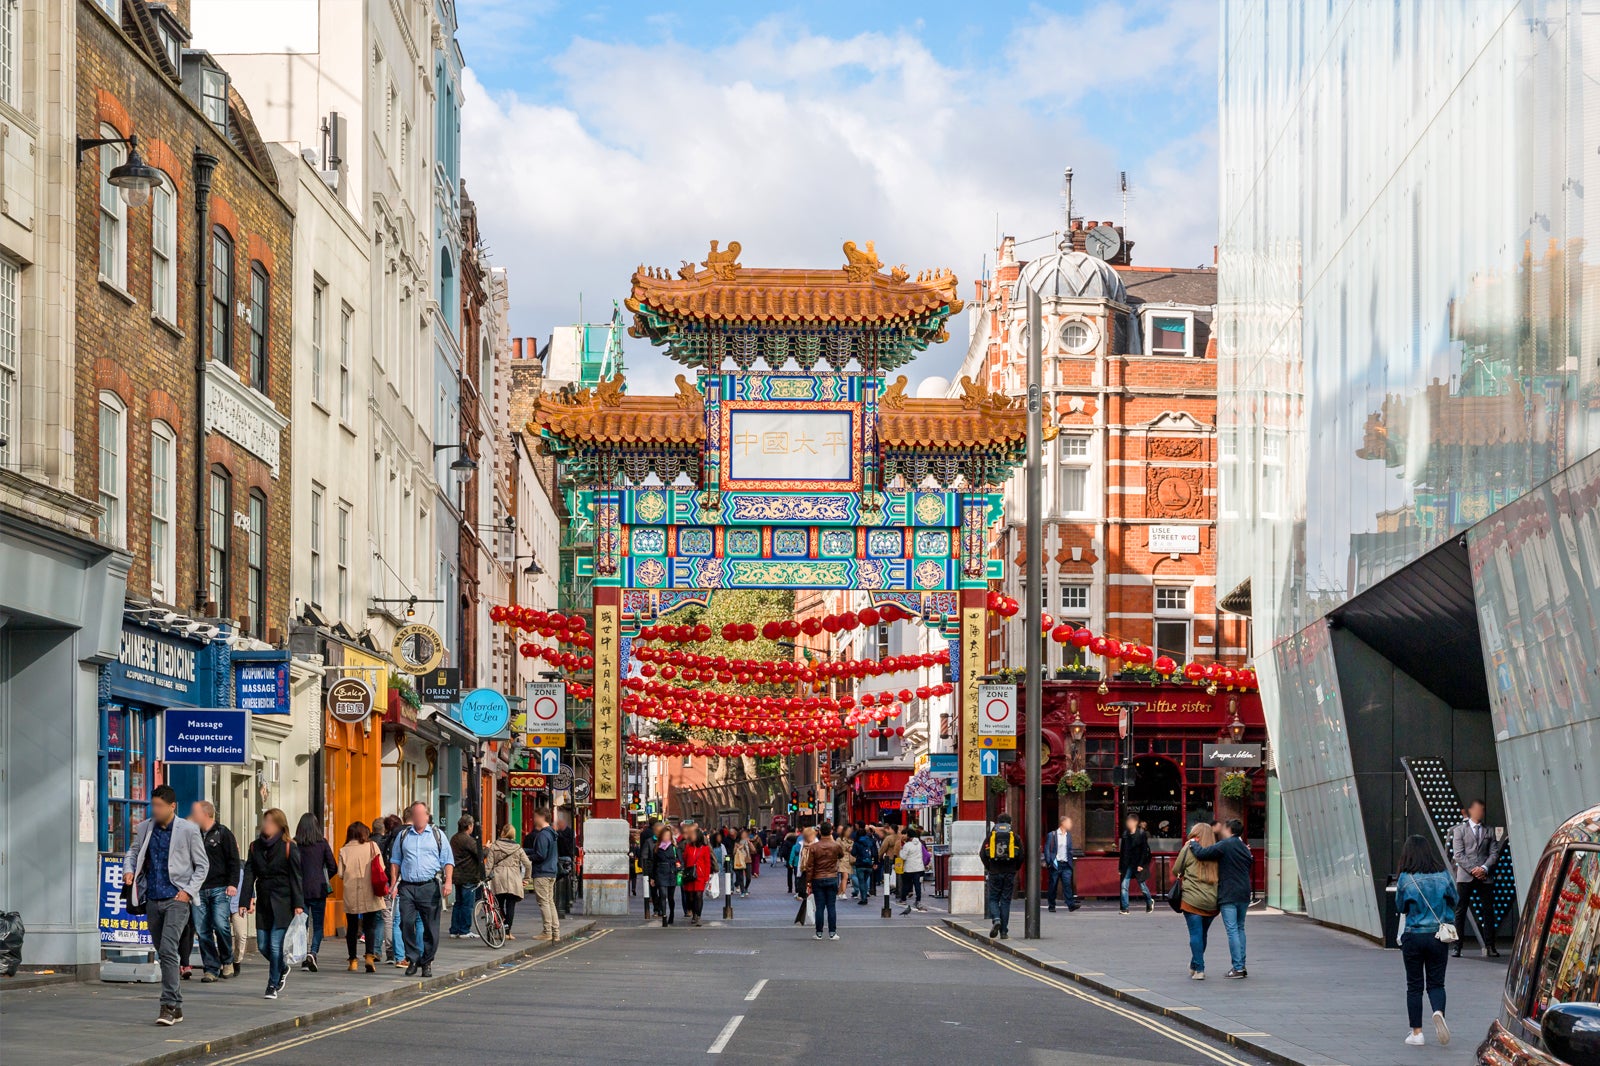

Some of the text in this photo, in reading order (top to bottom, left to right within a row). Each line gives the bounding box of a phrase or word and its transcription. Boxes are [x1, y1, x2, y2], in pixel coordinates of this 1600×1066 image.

[394, 628, 409, 647] WAXY
[118, 630, 195, 682] CHINESE MEDICINE
[242, 668, 275, 679] ACUPUNCTURE
[404, 665, 427, 673] LONDON
[126, 670, 155, 685] ACUPUNCTURE
[242, 684, 276, 692] MASSAGE
[242, 698, 275, 708] CHINESE MEDICINE
[336, 702, 364, 714] 麵包屋
[466, 701, 504, 711] Morden
[1180, 701, 1212, 713] sister
[474, 712, 498, 723] & Lea
[188, 720, 223, 728] Massage
[178, 733, 233, 741] Acupuncture
[168, 745, 242, 753] Chinese Medicine
